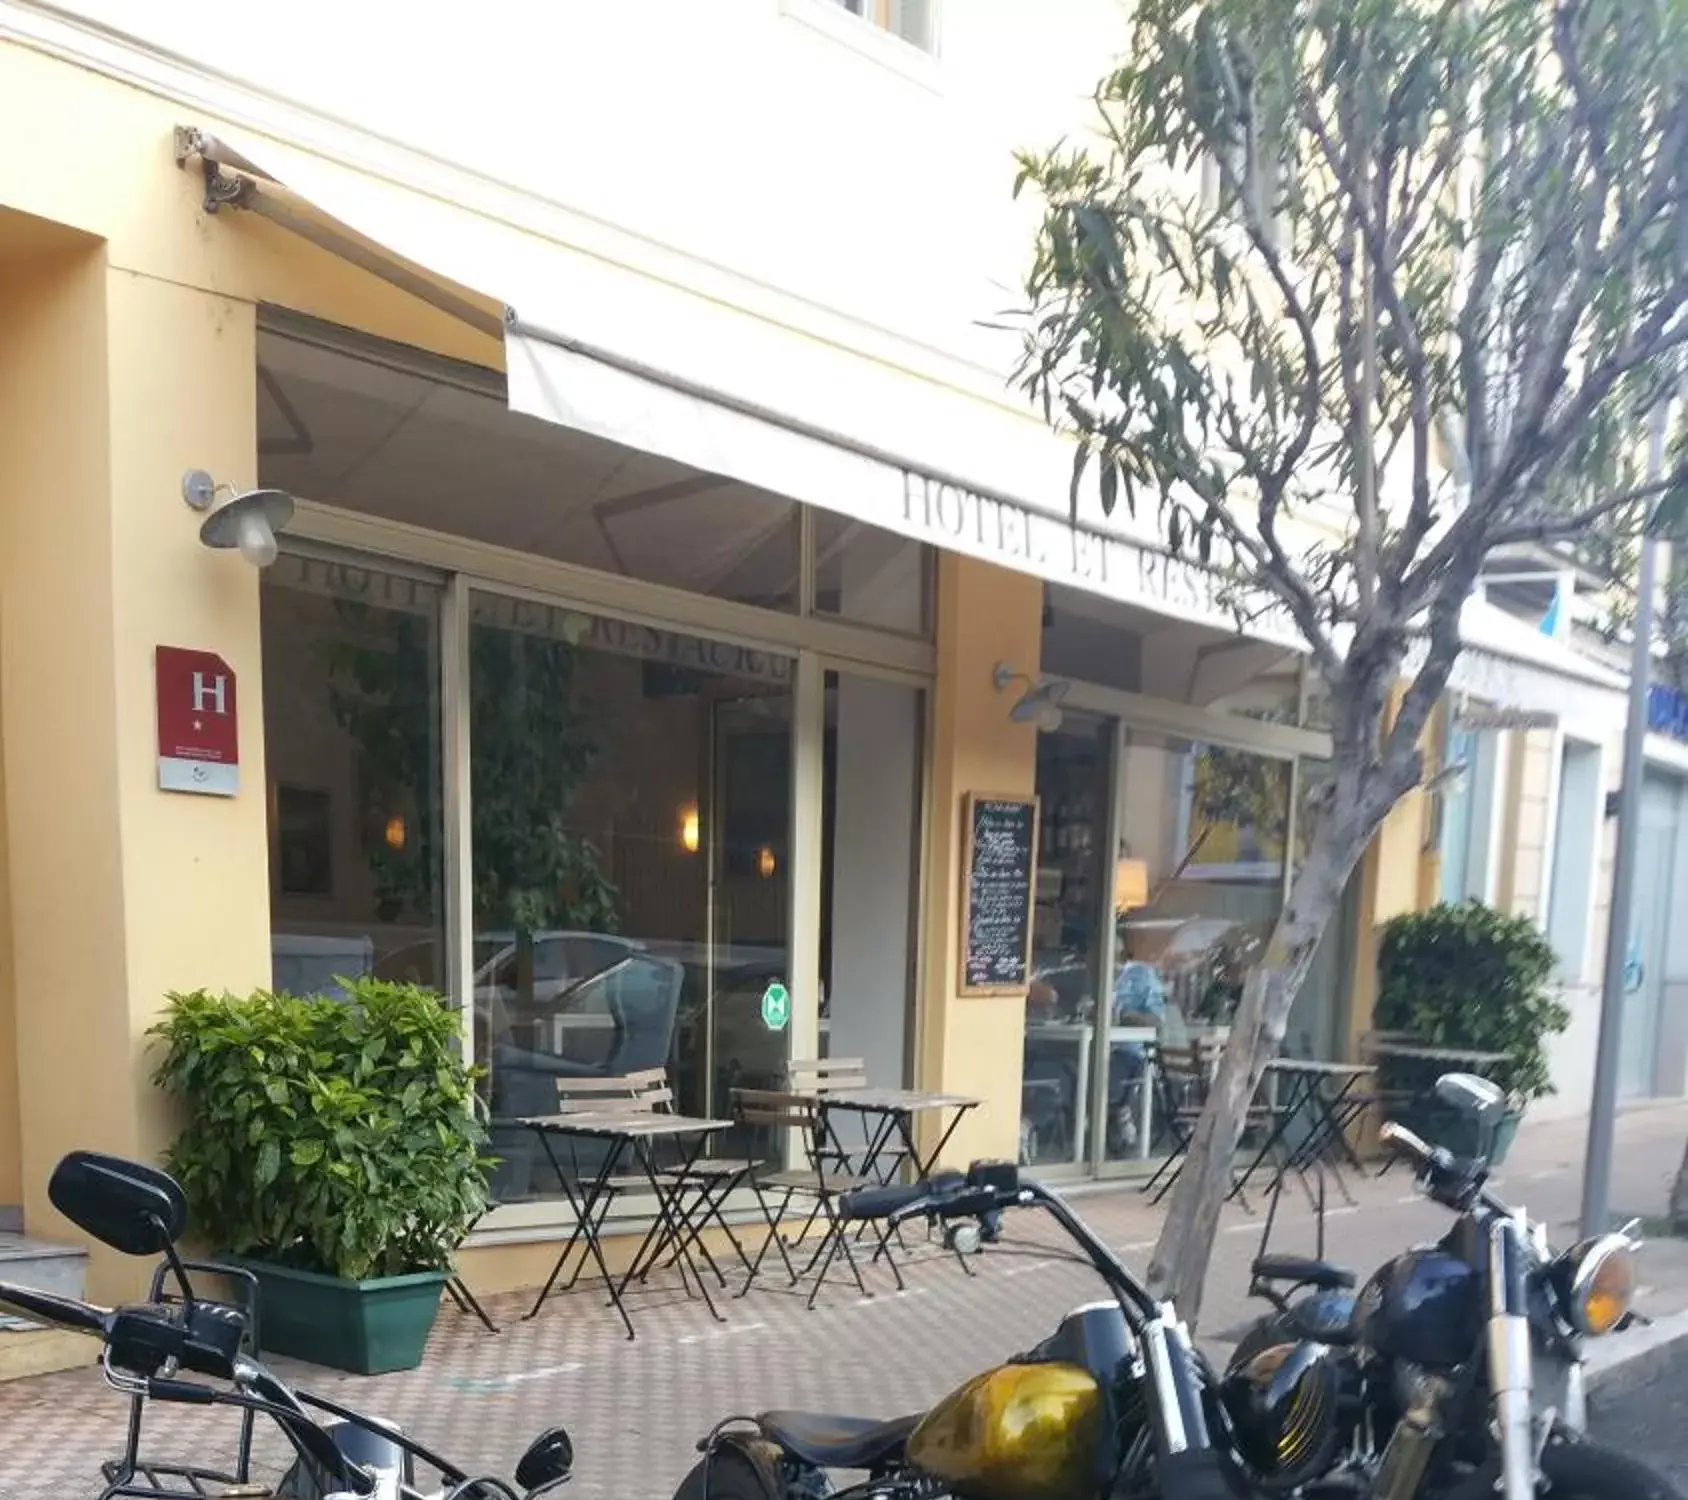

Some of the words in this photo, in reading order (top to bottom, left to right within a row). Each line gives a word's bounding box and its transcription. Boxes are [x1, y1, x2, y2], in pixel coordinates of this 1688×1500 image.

[902, 466, 1046, 564] HOTEL
[1070, 521, 1112, 582] ET
[192, 672, 227, 713] H
